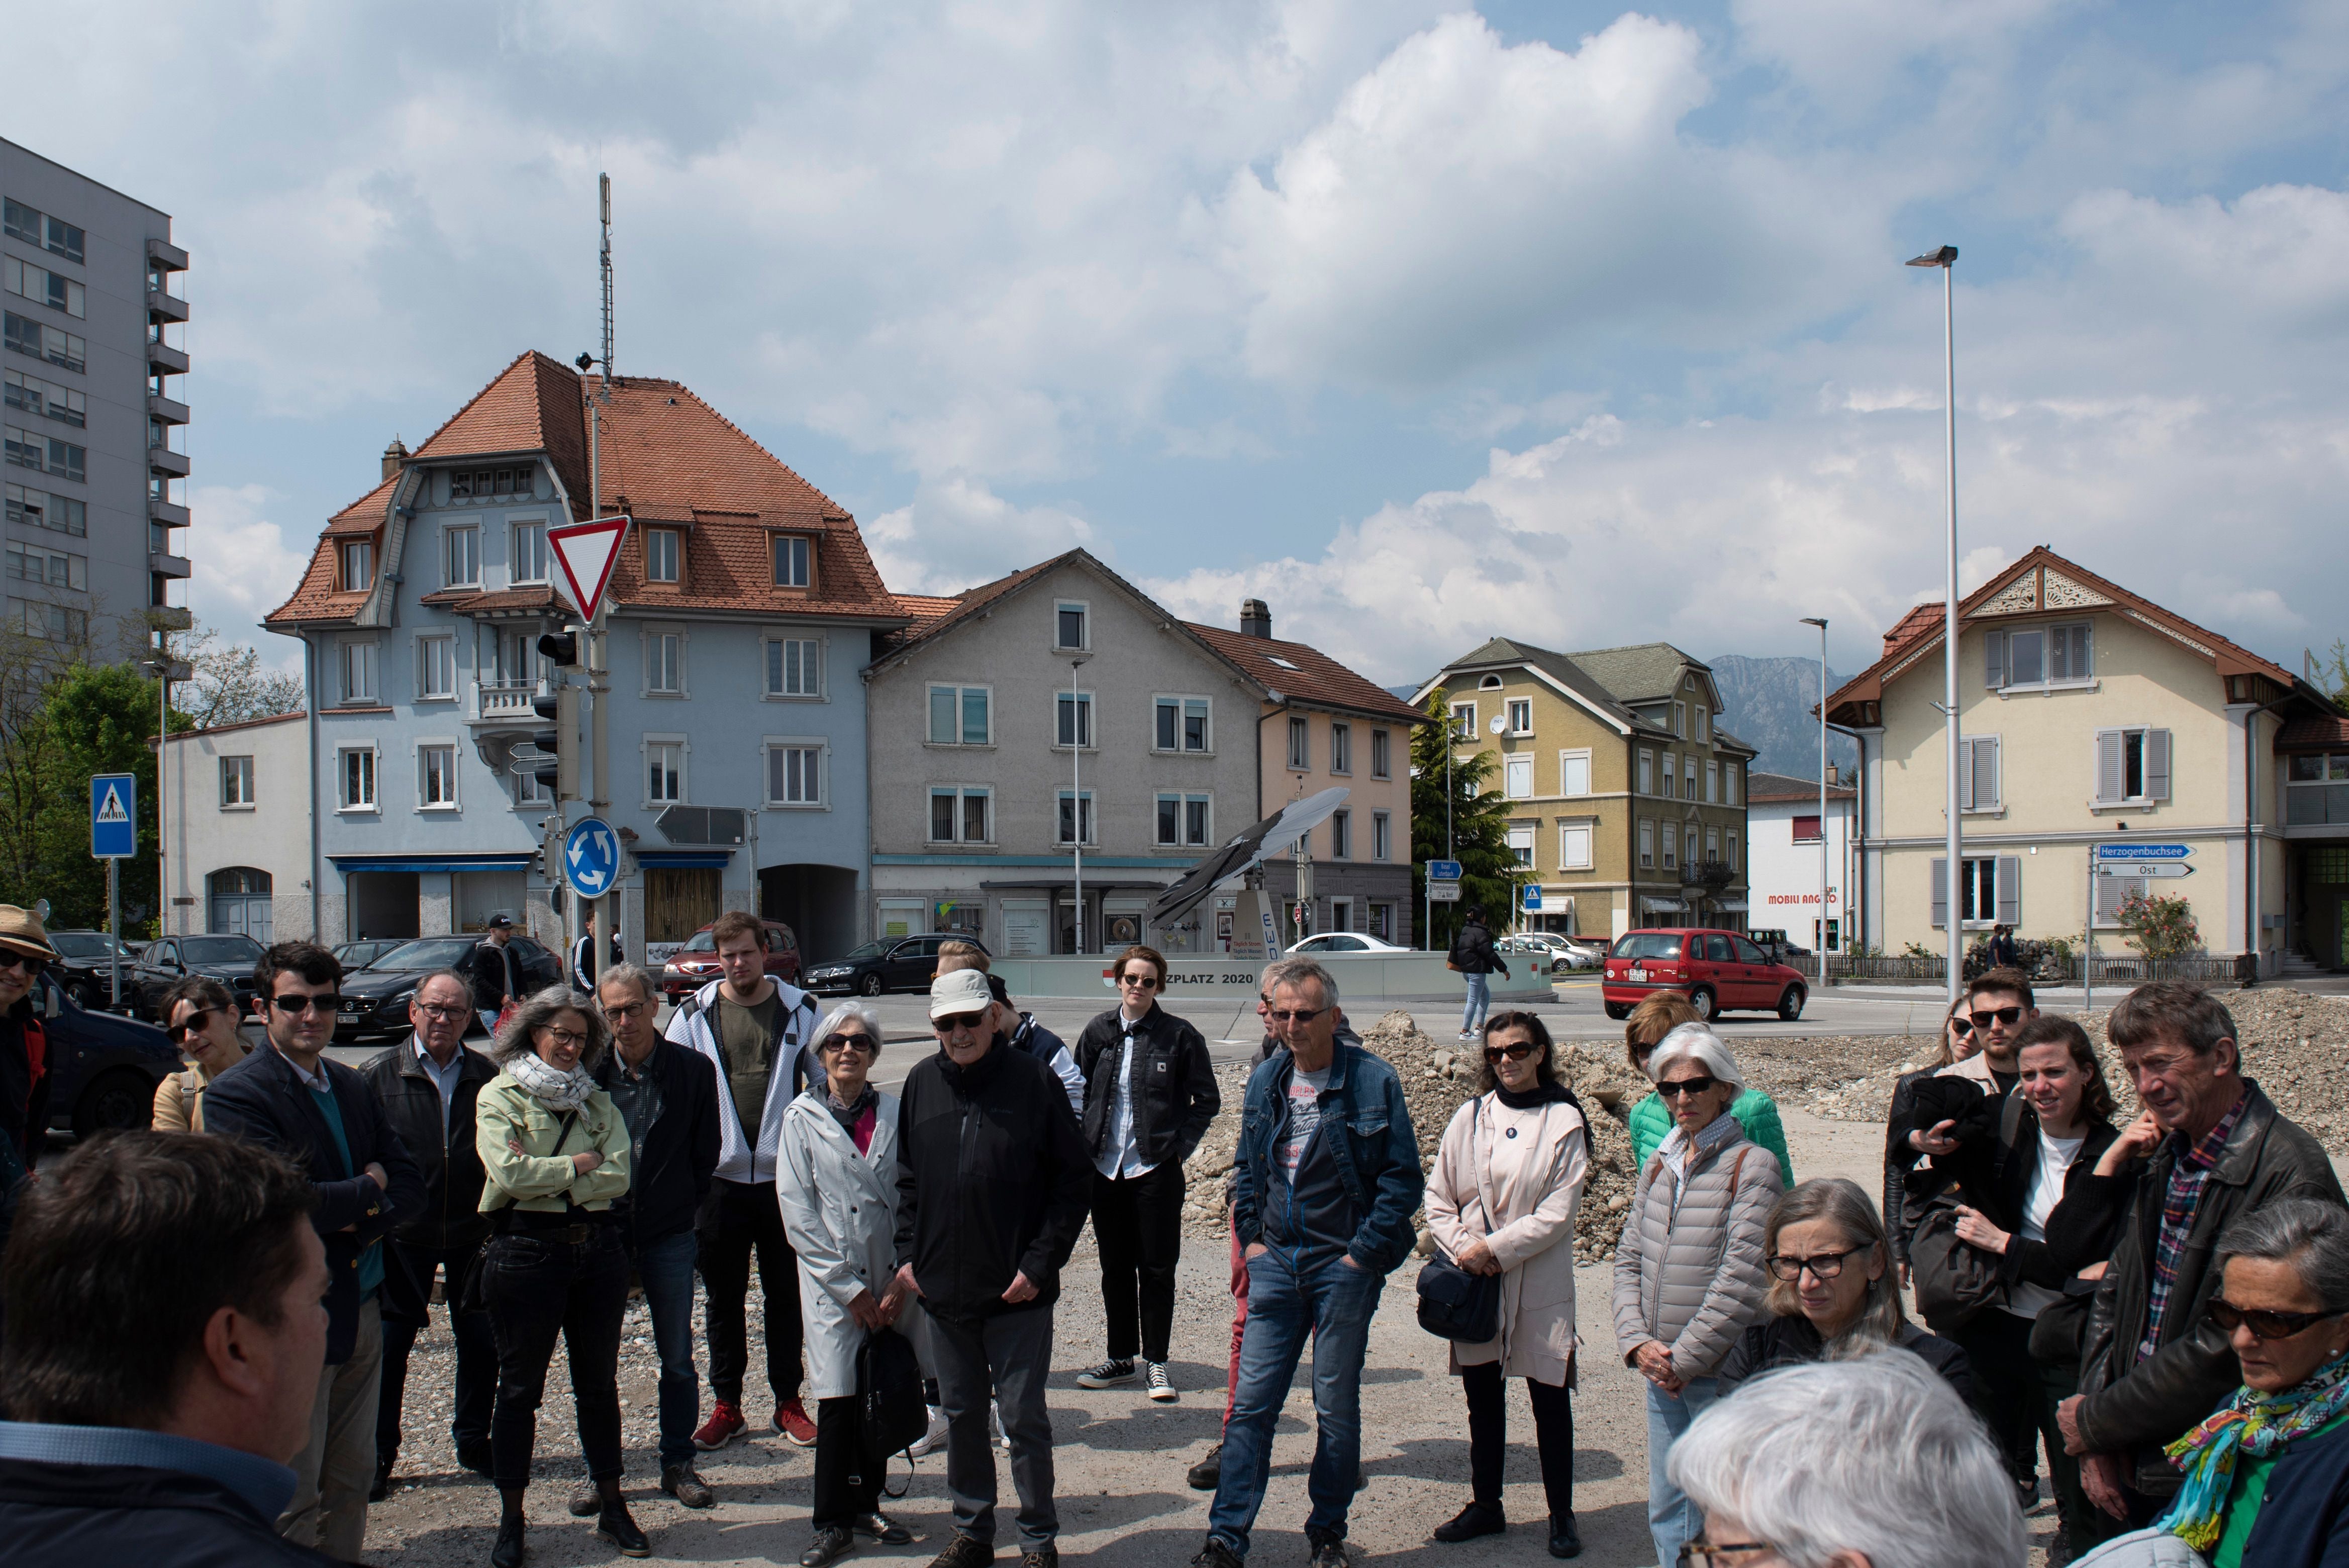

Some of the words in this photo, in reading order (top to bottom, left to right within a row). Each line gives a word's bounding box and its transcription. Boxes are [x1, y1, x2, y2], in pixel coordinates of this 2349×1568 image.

[2102, 847, 2182, 857] Herzogenbuchsee
[2140, 866, 2157, 874] Ost
[1769, 895, 1799, 904] MOBILI
[1222, 974, 1253, 984] 2020
[1285, 1145, 1299, 1157] 63
